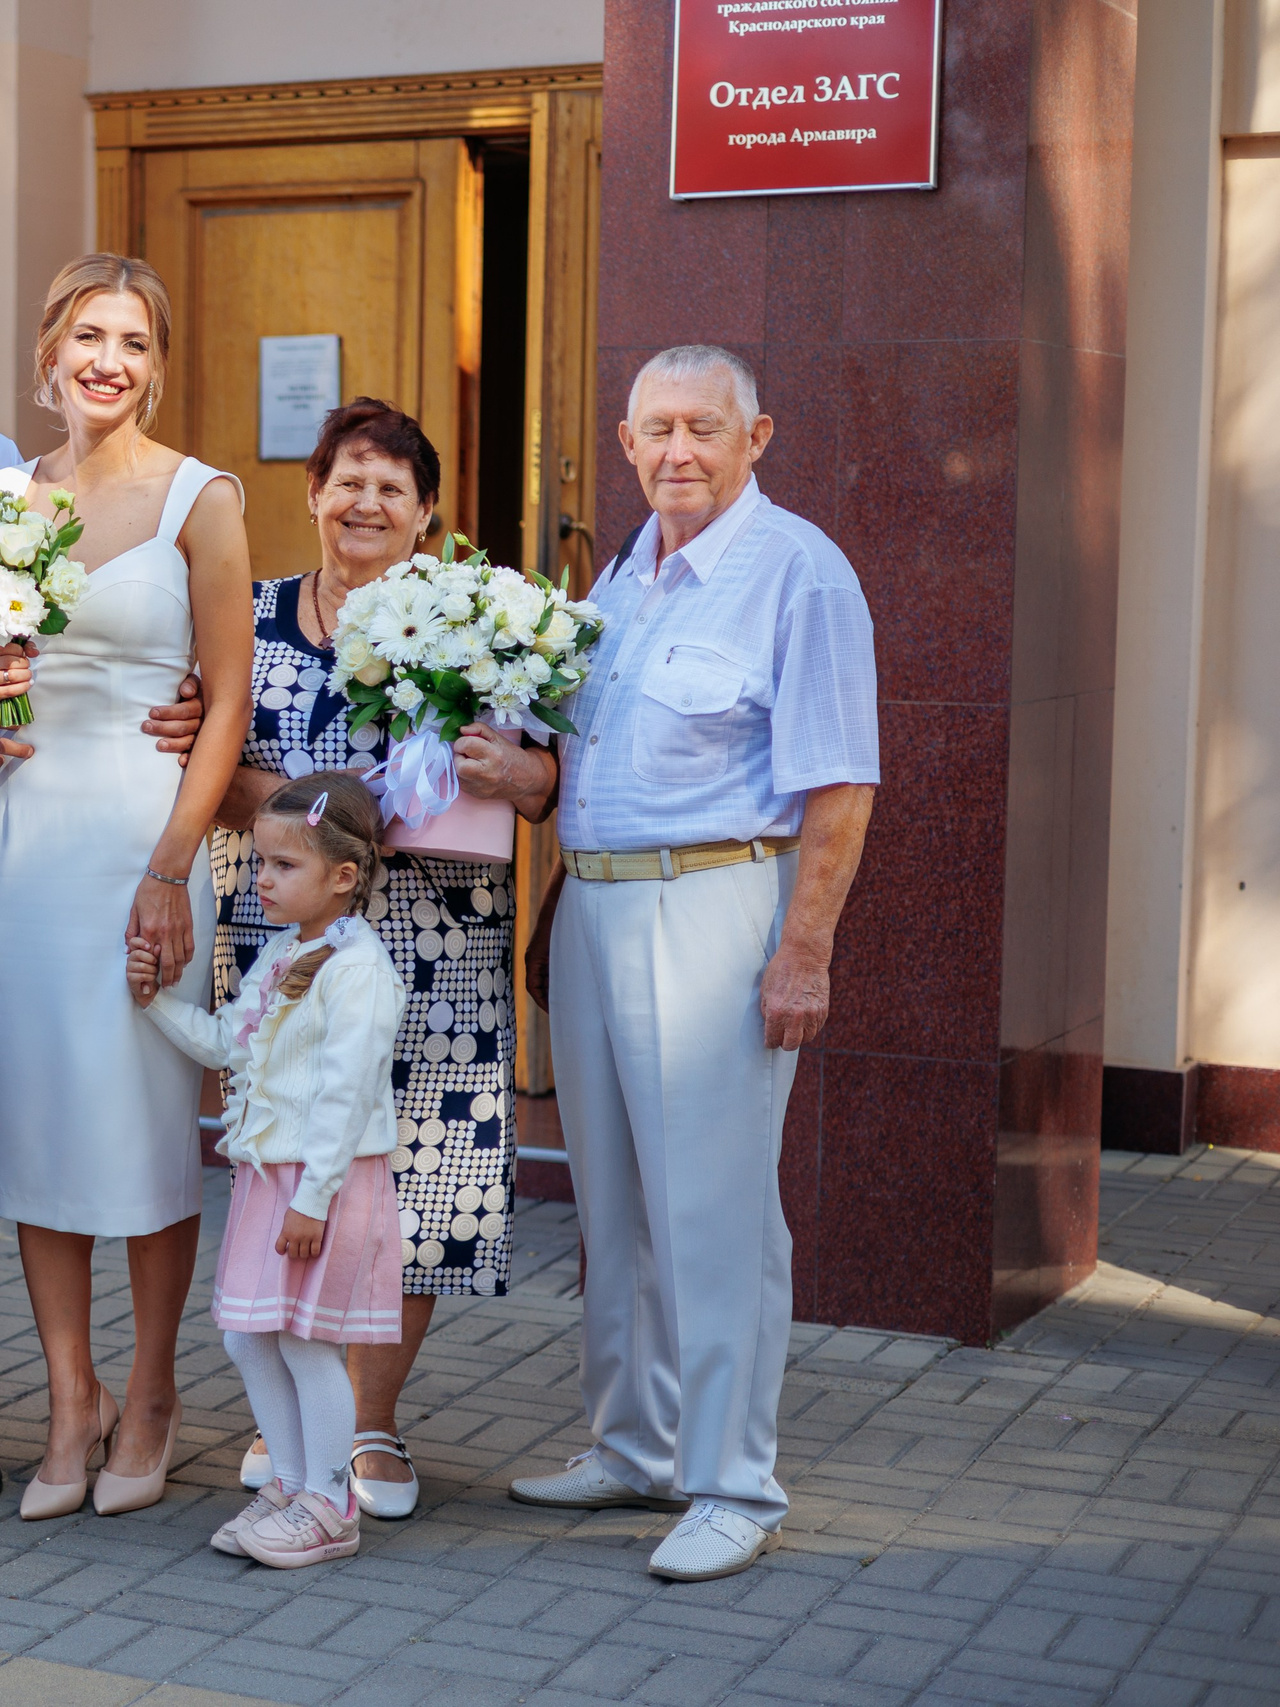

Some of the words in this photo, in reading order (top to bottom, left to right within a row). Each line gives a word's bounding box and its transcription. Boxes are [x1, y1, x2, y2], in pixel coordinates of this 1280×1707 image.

[717, 0, 818, 17] гражданского
[729, 17, 847, 36] Краснодарского
[850, 13, 886, 31] края
[709, 81, 805, 110] Отдел
[813, 72, 900, 102] ЗАГС
[728, 131, 786, 149] города
[790, 127, 877, 146] Армавира
